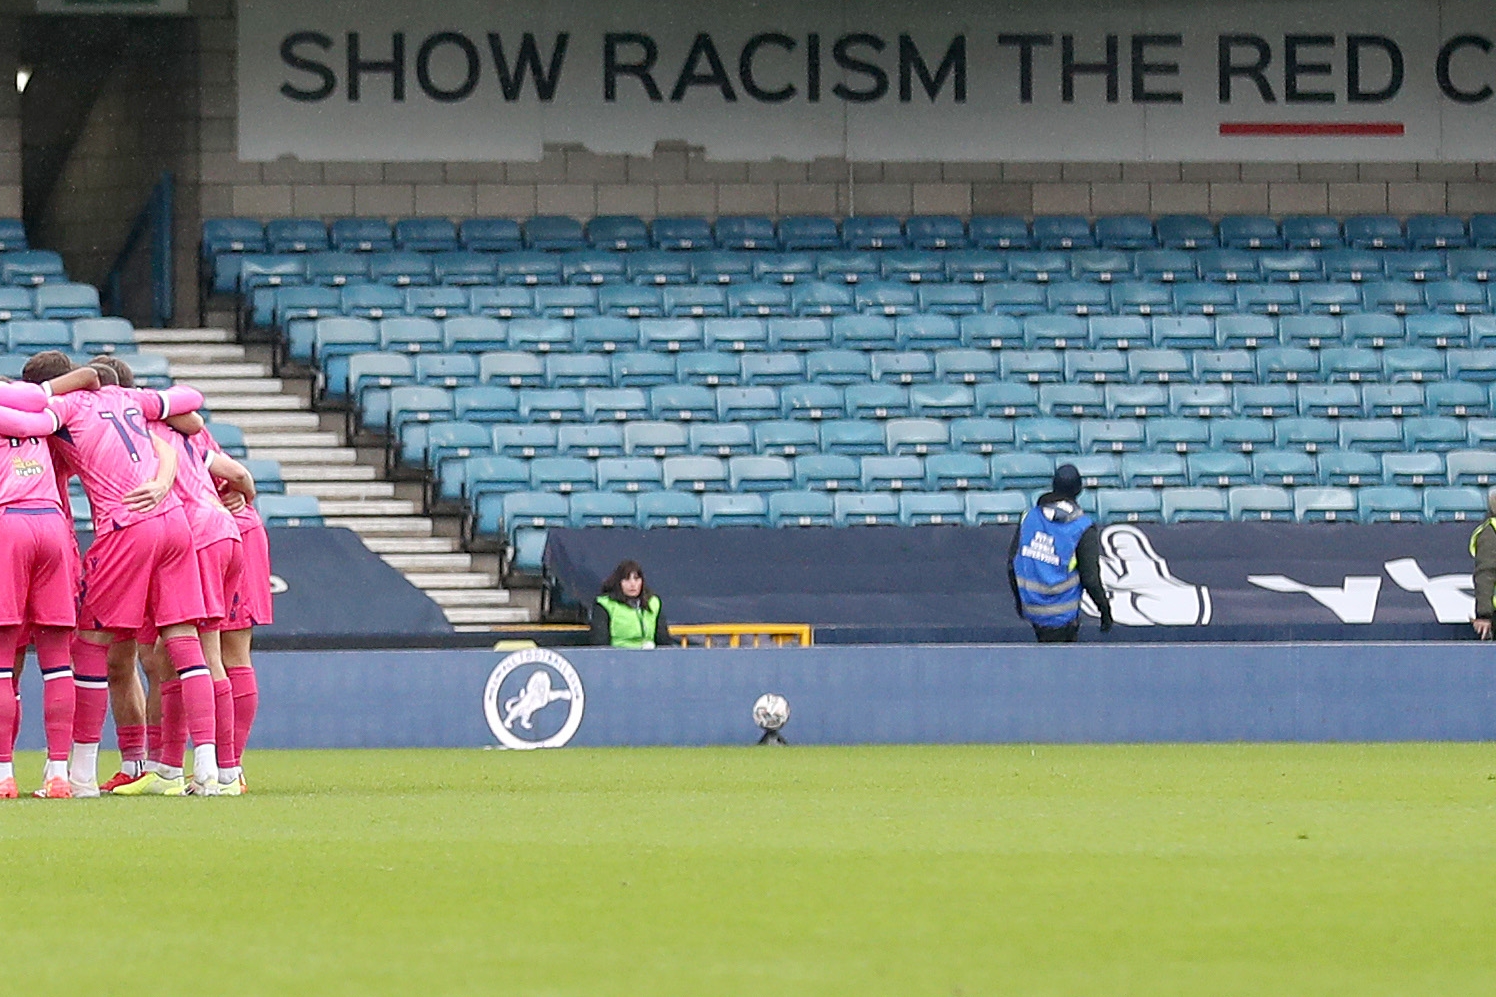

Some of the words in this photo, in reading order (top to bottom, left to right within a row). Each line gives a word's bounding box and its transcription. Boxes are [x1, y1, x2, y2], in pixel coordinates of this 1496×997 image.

[278, 30, 570, 103] SHOW
[602, 30, 967, 103] RACISM
[996, 31, 1183, 103] THE
[1218, 32, 1405, 103] RED
[1435, 32, 1495, 103] C
